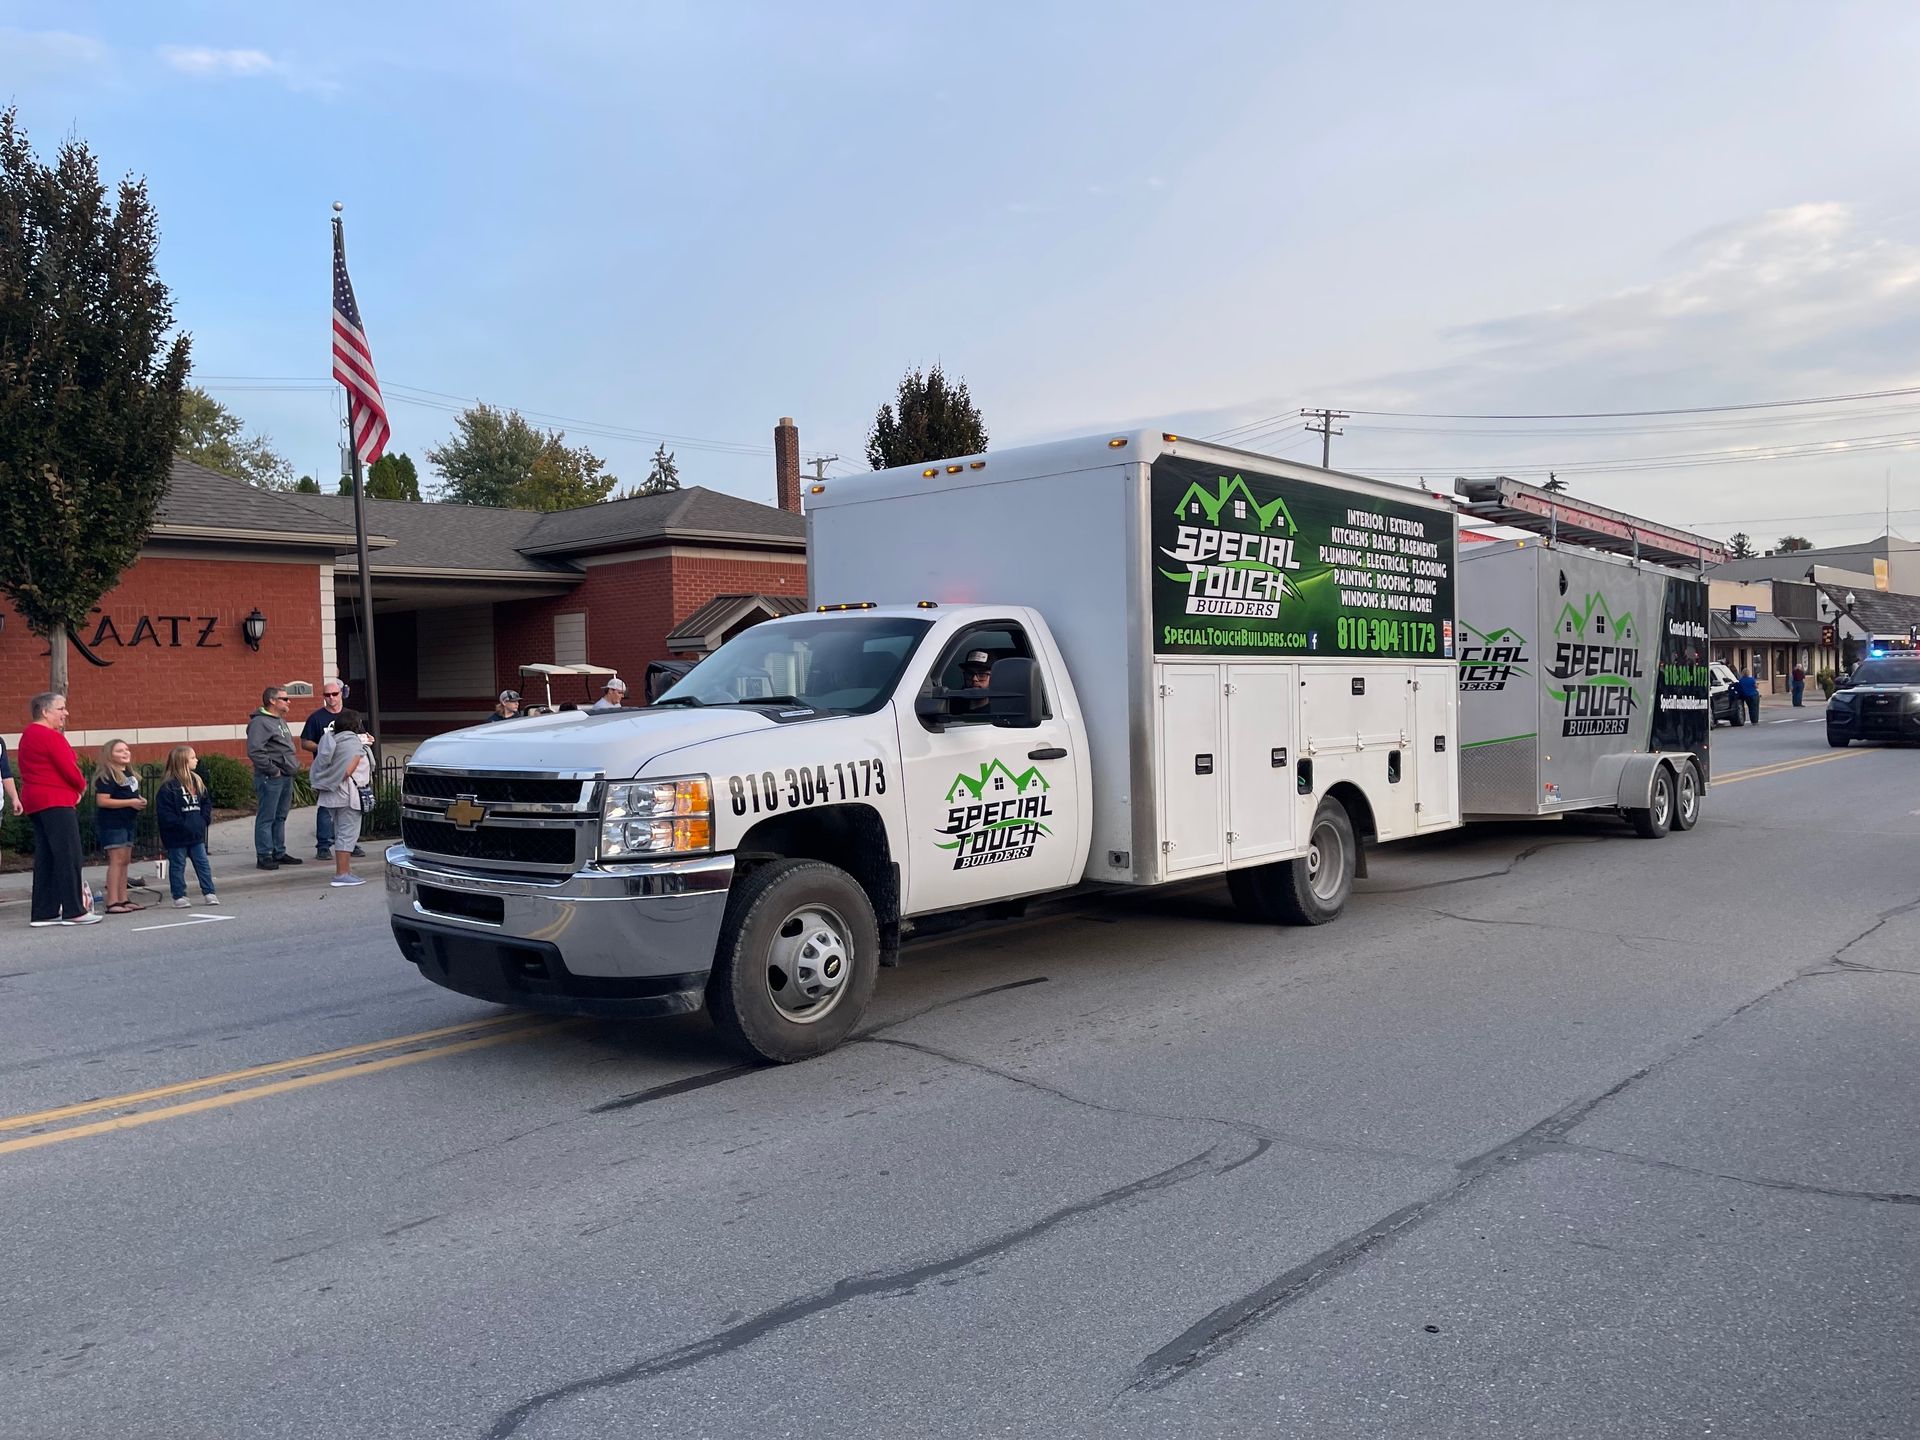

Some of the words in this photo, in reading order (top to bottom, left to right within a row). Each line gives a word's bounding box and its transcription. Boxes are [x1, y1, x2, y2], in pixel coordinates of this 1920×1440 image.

[1347, 508, 1384, 531] INTERIOR
[1390, 516, 1425, 538] EXTERIOR
[1174, 525, 1301, 570] SPECIAL
[1331, 526, 1369, 548] KITCHENS
[1372, 533, 1396, 552] BATHS
[1400, 538, 1438, 558] BASEMENTS
[1319, 545, 1362, 567] PLUMBING
[1366, 552, 1409, 573] ELECTRICAL
[1412, 559, 1447, 578] FLOORING
[1185, 563, 1293, 601] TOUCH
[1334, 568, 1373, 588] PAINTING
[1376, 573, 1411, 592] ROOFING
[1414, 579, 1437, 595] SIDING
[1195, 599, 1274, 616] BUILDERS
[1341, 589, 1379, 609] WINDOWS
[1380, 593, 1387, 609] &
[1387, 594, 1408, 612] MUCH
[1409, 597, 1433, 613] MORE!
[1337, 616, 1436, 653] 810-304-1173
[1459, 647, 1529, 662] CIAL
[1554, 642, 1643, 678] SPECIAL
[1563, 685, 1638, 717] TOUCH
[1568, 719, 1625, 736] BUILDERS
[728, 758, 887, 817] 810-304-1173
[946, 795, 1053, 834] SPECIAL
[955, 822, 1046, 857] TOUCH
[960, 847, 1029, 869] BUILDERS
